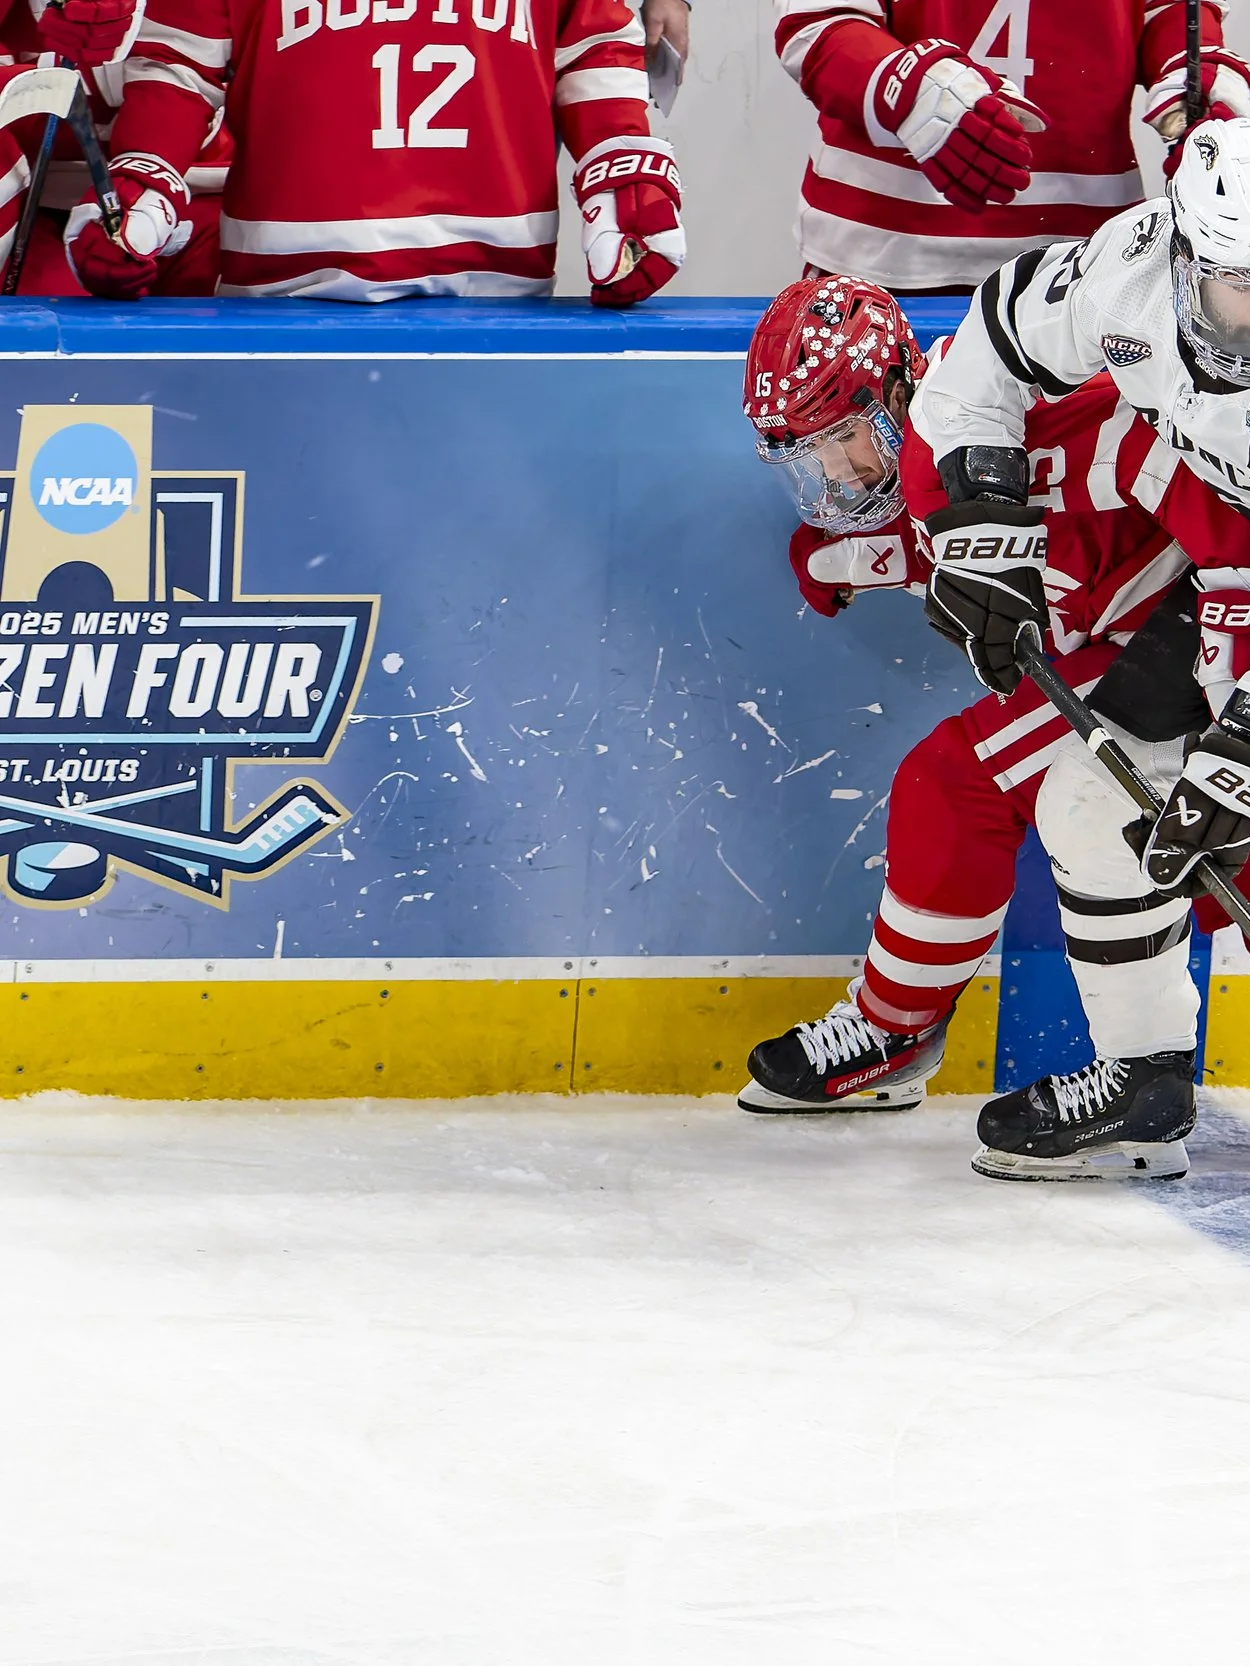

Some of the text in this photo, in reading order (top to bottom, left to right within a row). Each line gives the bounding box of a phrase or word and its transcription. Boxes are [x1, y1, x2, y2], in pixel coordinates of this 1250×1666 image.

[371, 43, 477, 149] 12
[1103, 337, 1152, 357] NCHC
[754, 371, 774, 398] 15
[752, 413, 788, 429] BOSTON
[38, 477, 133, 506] NCAA
[71, 612, 170, 636] MEN'S
[125, 643, 323, 719] FOUR
[42, 759, 140, 782] LOUIS
